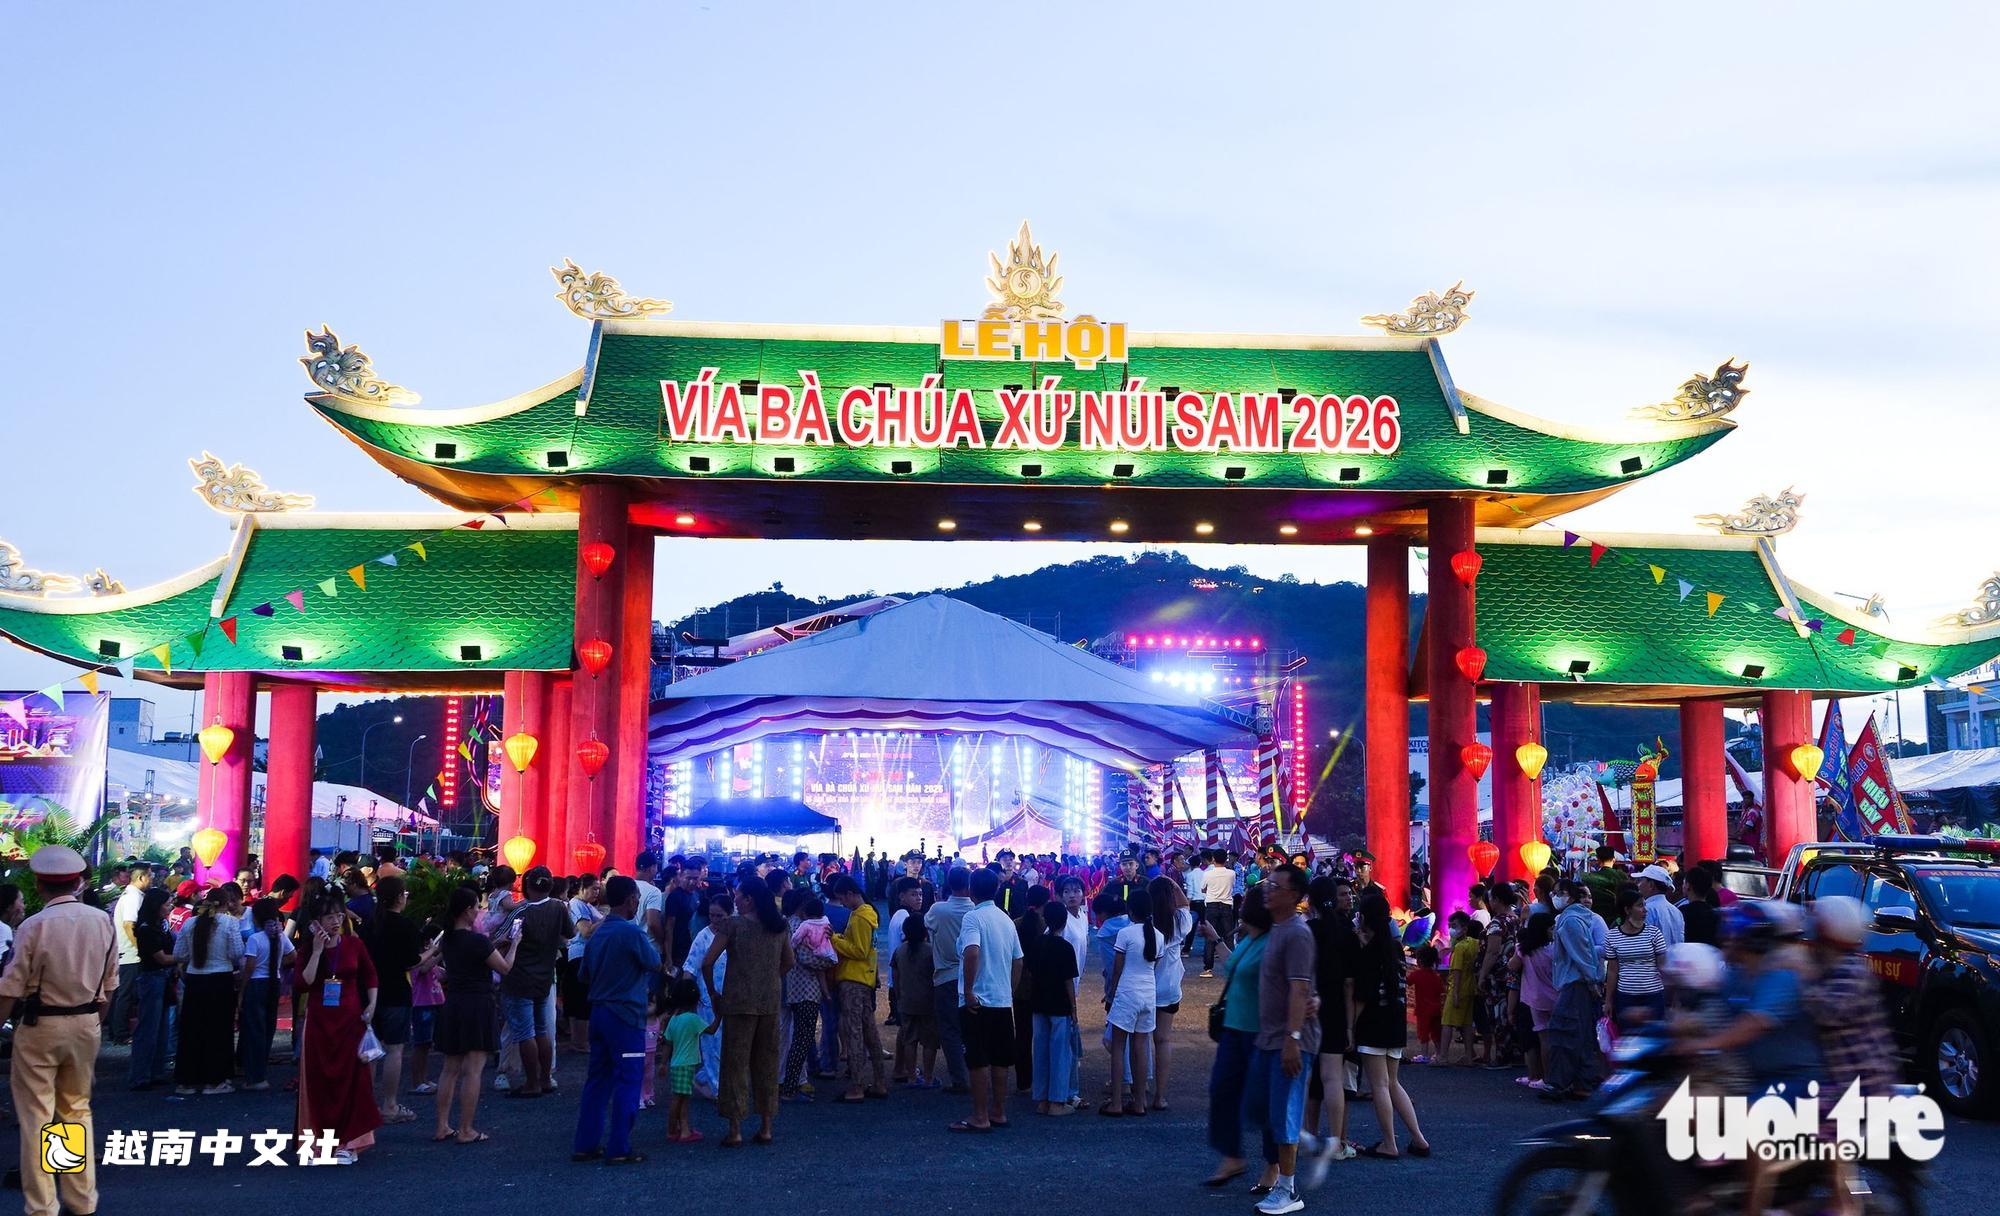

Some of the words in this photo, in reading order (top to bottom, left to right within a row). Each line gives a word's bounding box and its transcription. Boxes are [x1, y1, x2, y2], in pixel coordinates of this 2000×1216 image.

[941, 312, 1014, 359] LỄ
[1021, 315, 1128, 369] HỘI
[661, 368, 751, 443] VÍA
[757, 370, 834, 446] BÀ
[837, 373, 986, 448] CHÚA
[992, 376, 1076, 450] XỨ
[1082, 377, 1167, 450] NÚI
[1172, 391, 1284, 452] SAM
[1288, 394, 1401, 455] 2026
